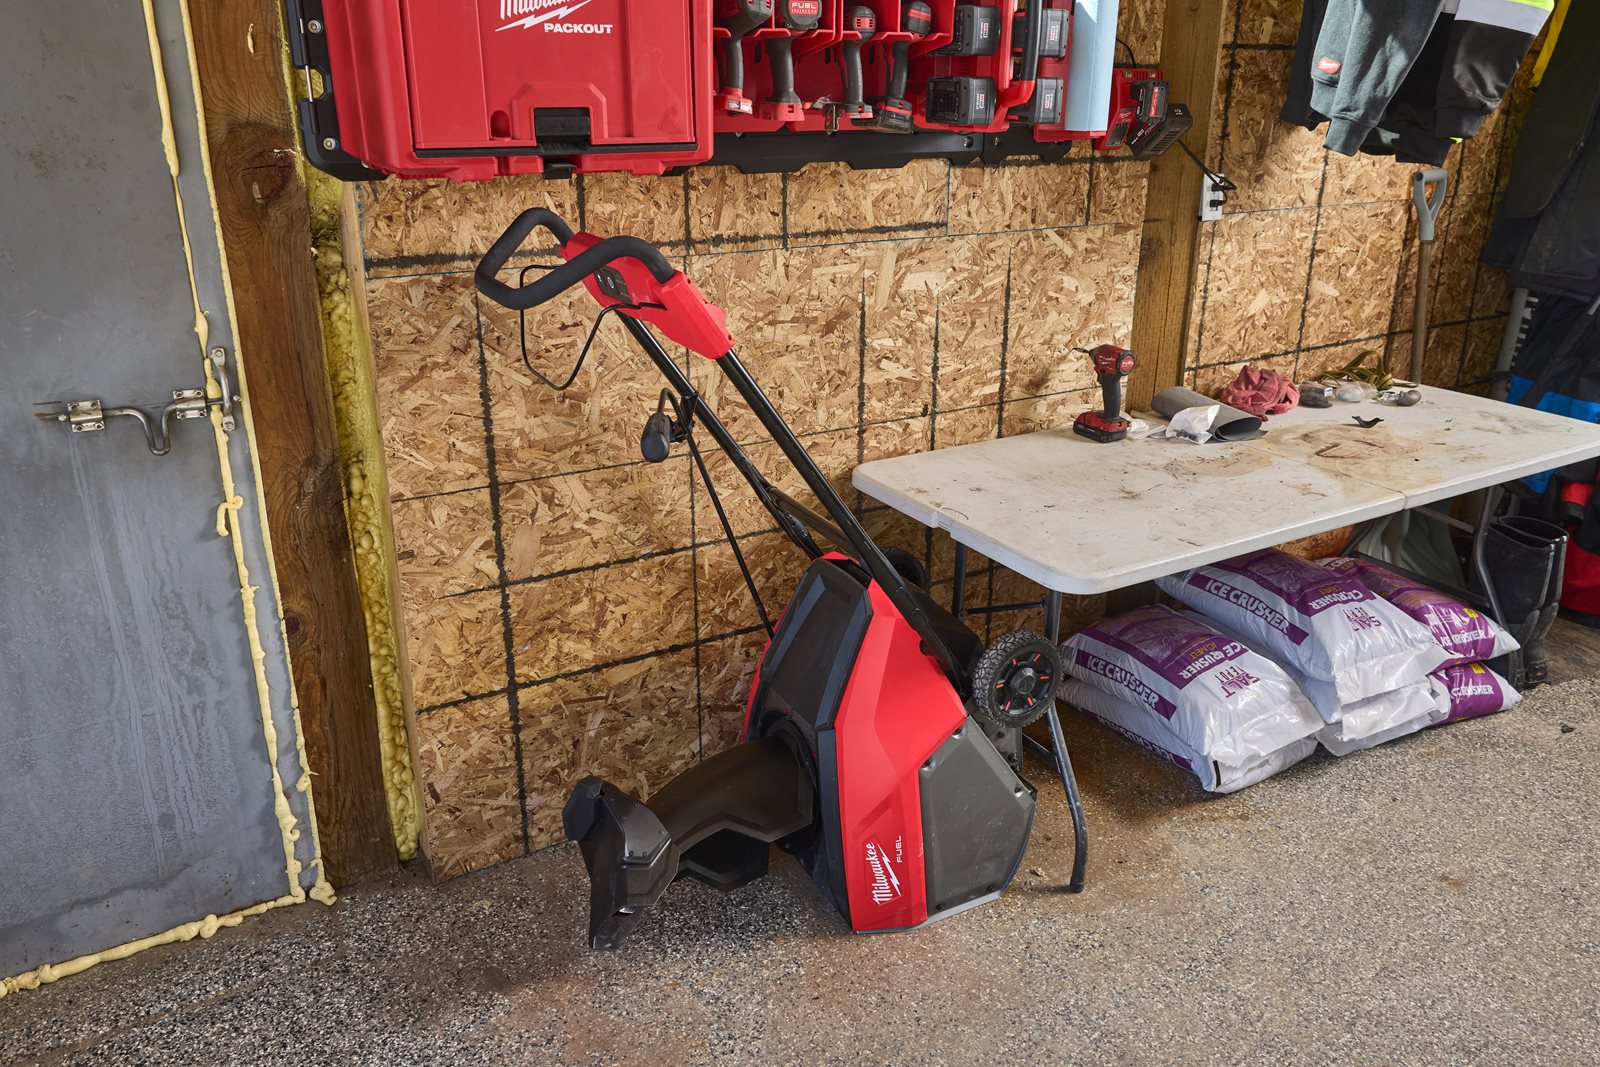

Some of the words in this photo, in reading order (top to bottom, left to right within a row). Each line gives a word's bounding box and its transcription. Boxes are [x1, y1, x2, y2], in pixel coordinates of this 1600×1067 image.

[544, 22, 613, 34] PACKOUT
[1205, 579, 1229, 598] ICE
[1229, 589, 1290, 634] CRUSHER
[1087, 655, 1106, 675] ICE
[1105, 663, 1160, 708] CRUSHER
[1221, 672, 1261, 699] SALT
[895, 835, 904, 863] FUEL
[865, 842, 893, 905] Milwaukee
